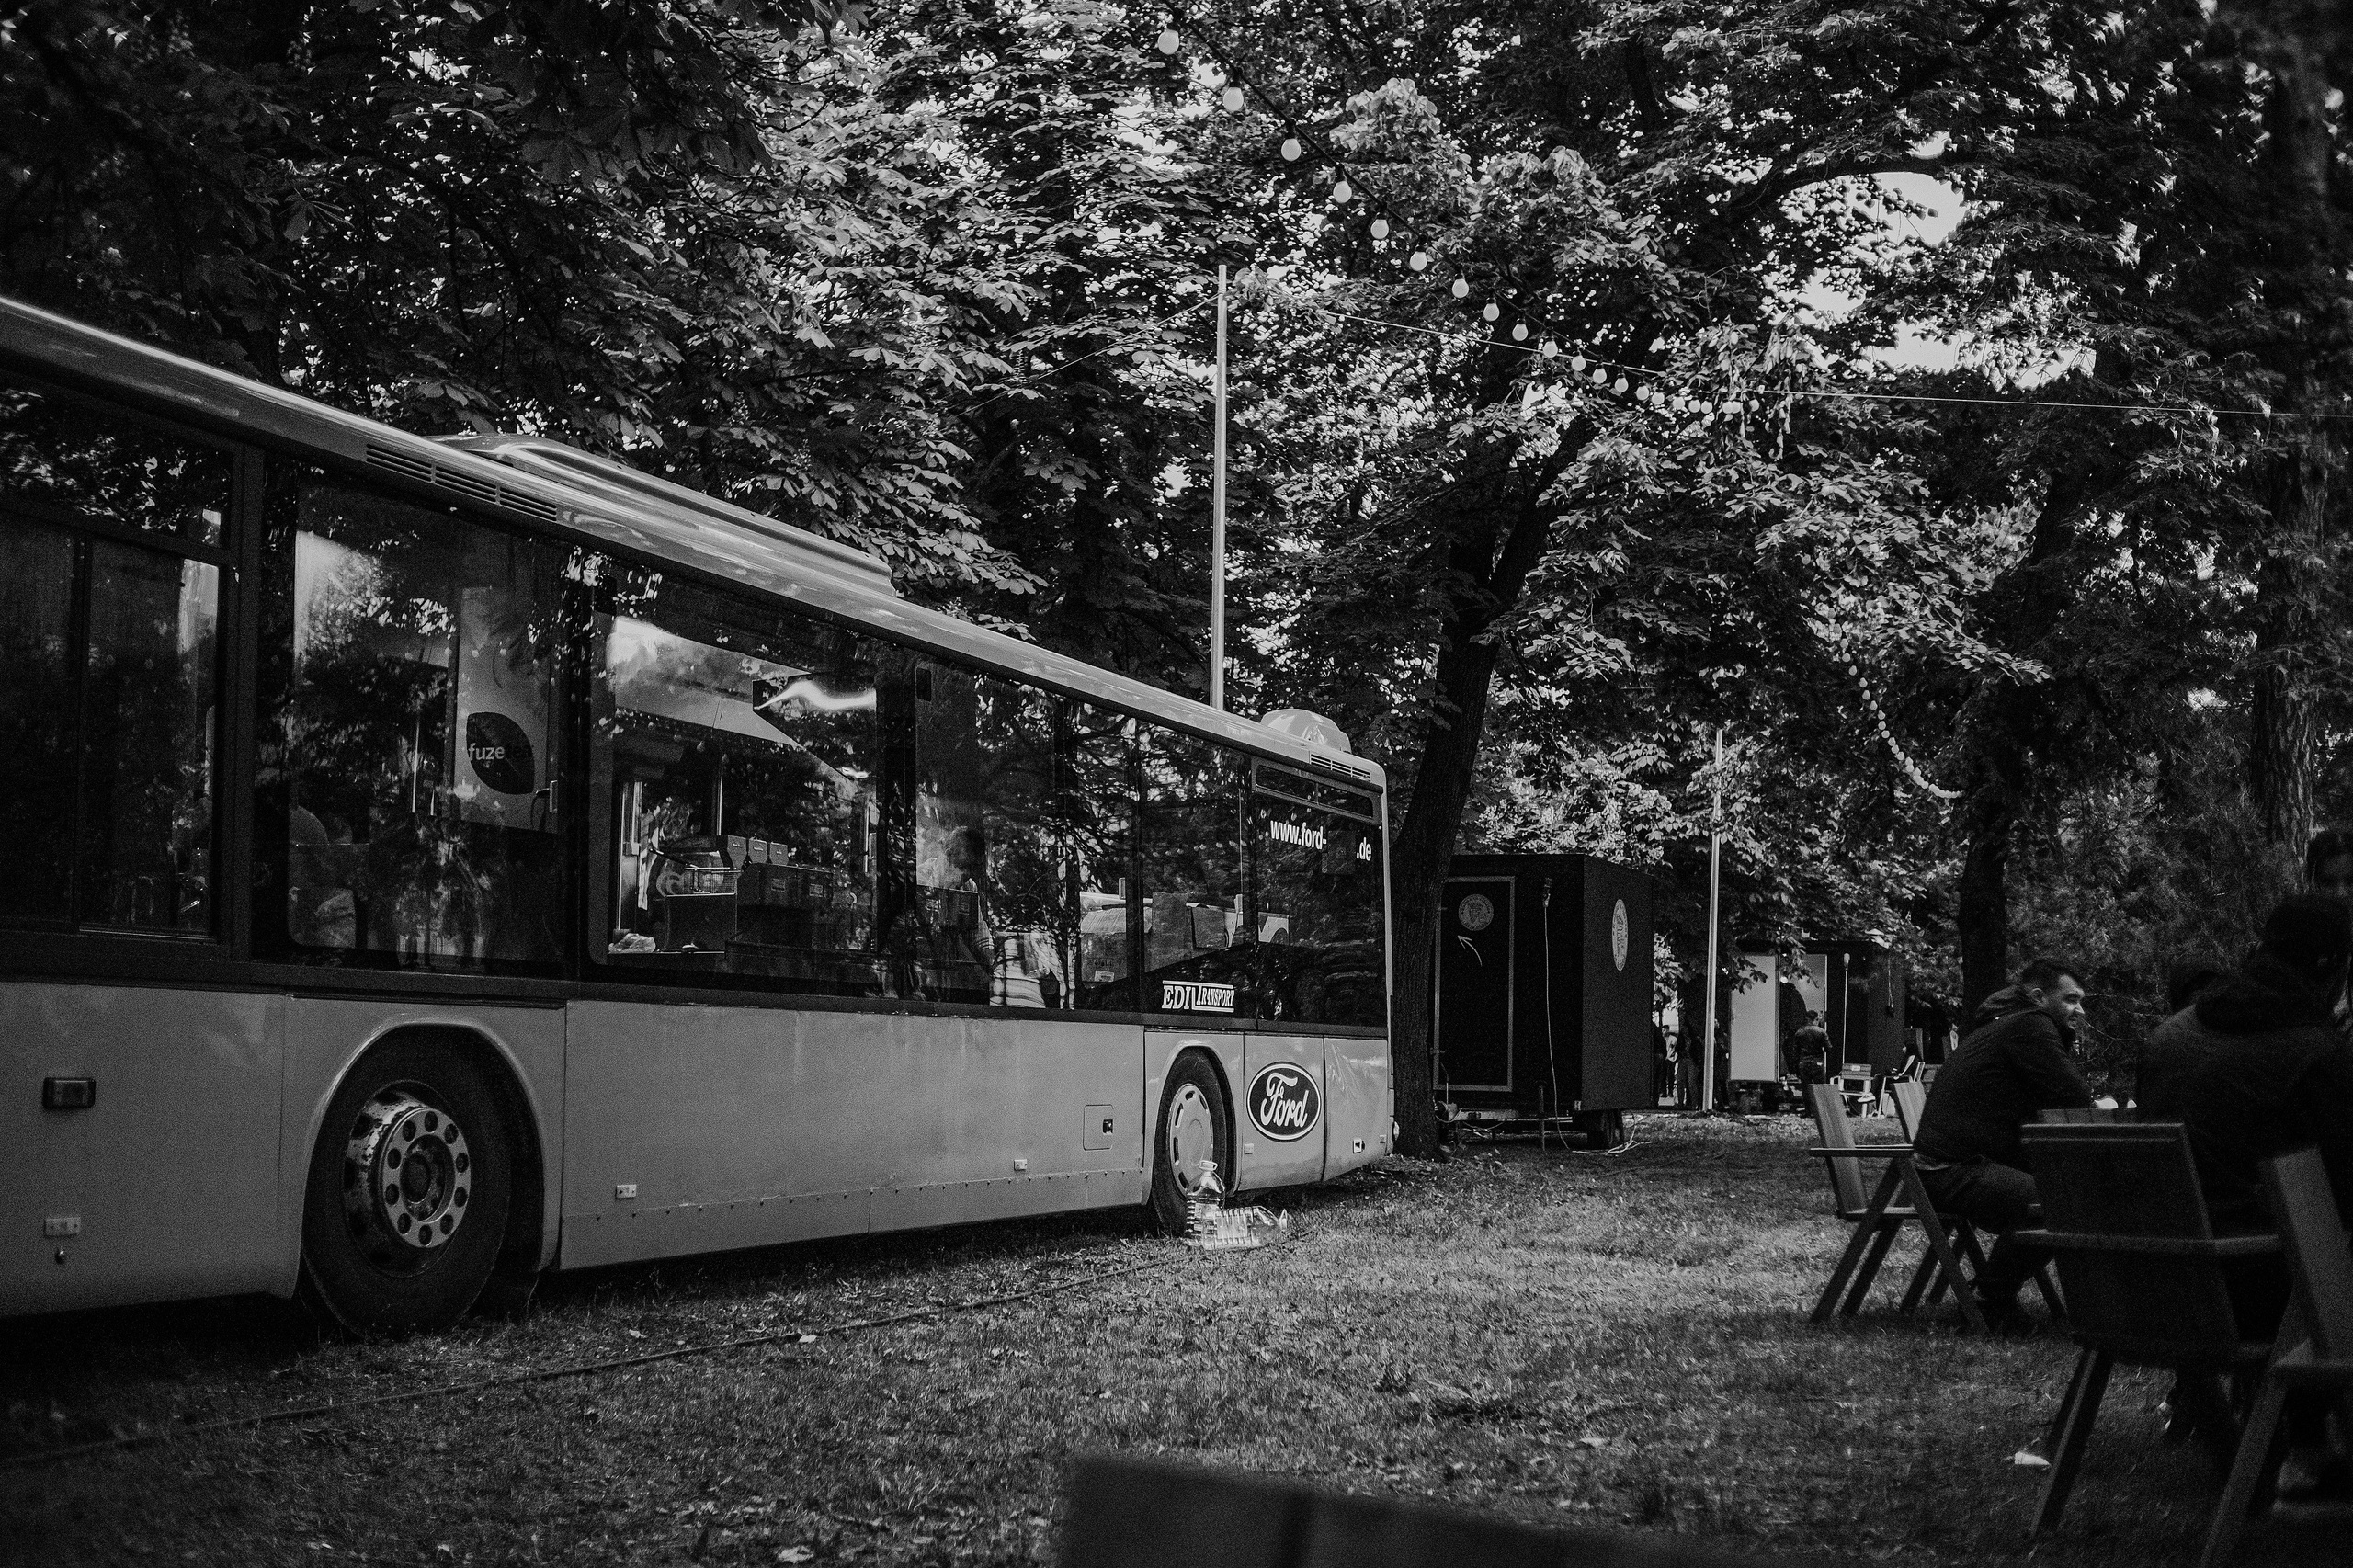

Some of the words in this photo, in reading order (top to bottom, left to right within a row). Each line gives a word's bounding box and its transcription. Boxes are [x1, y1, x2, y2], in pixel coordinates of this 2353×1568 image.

[1270, 820, 1327, 850] www.ford-
[1356, 836, 1372, 861] .de
[1260, 1072, 1310, 1128] Ford
